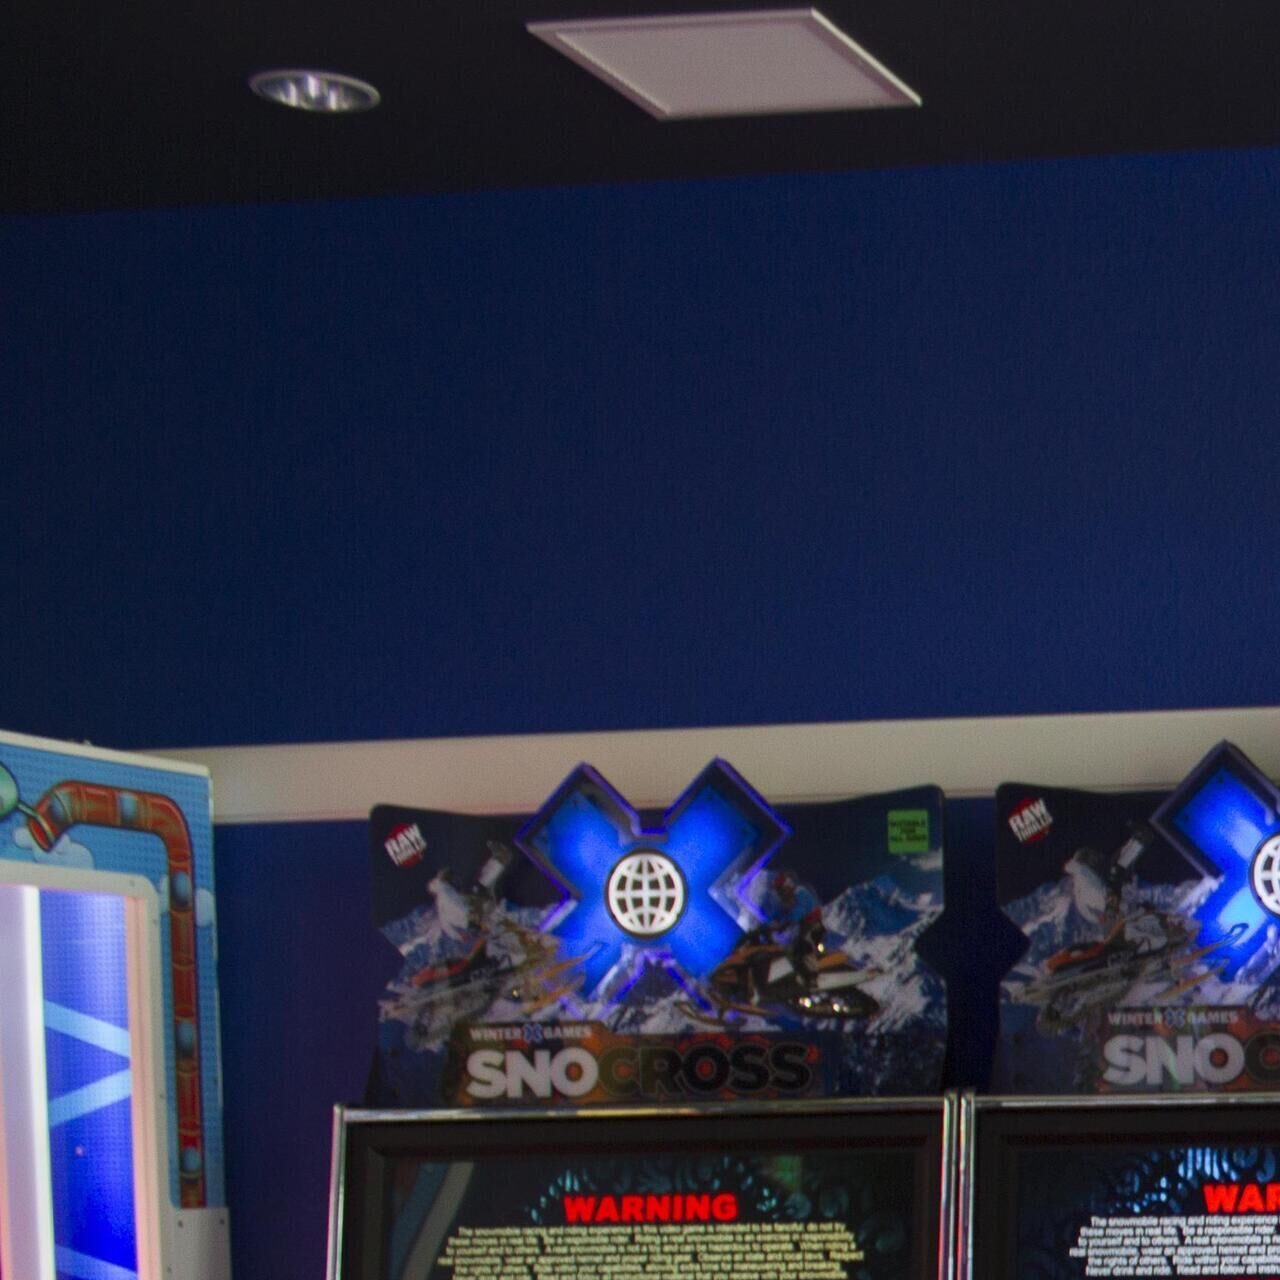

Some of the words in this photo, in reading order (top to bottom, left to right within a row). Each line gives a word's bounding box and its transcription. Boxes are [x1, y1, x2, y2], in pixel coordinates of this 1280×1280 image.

[1108, 1010, 1164, 1027] WINTER
[470, 1025, 523, 1042] WINTER
[542, 1024, 593, 1041] GAMES
[564, 1194, 738, 1223] WARNING
